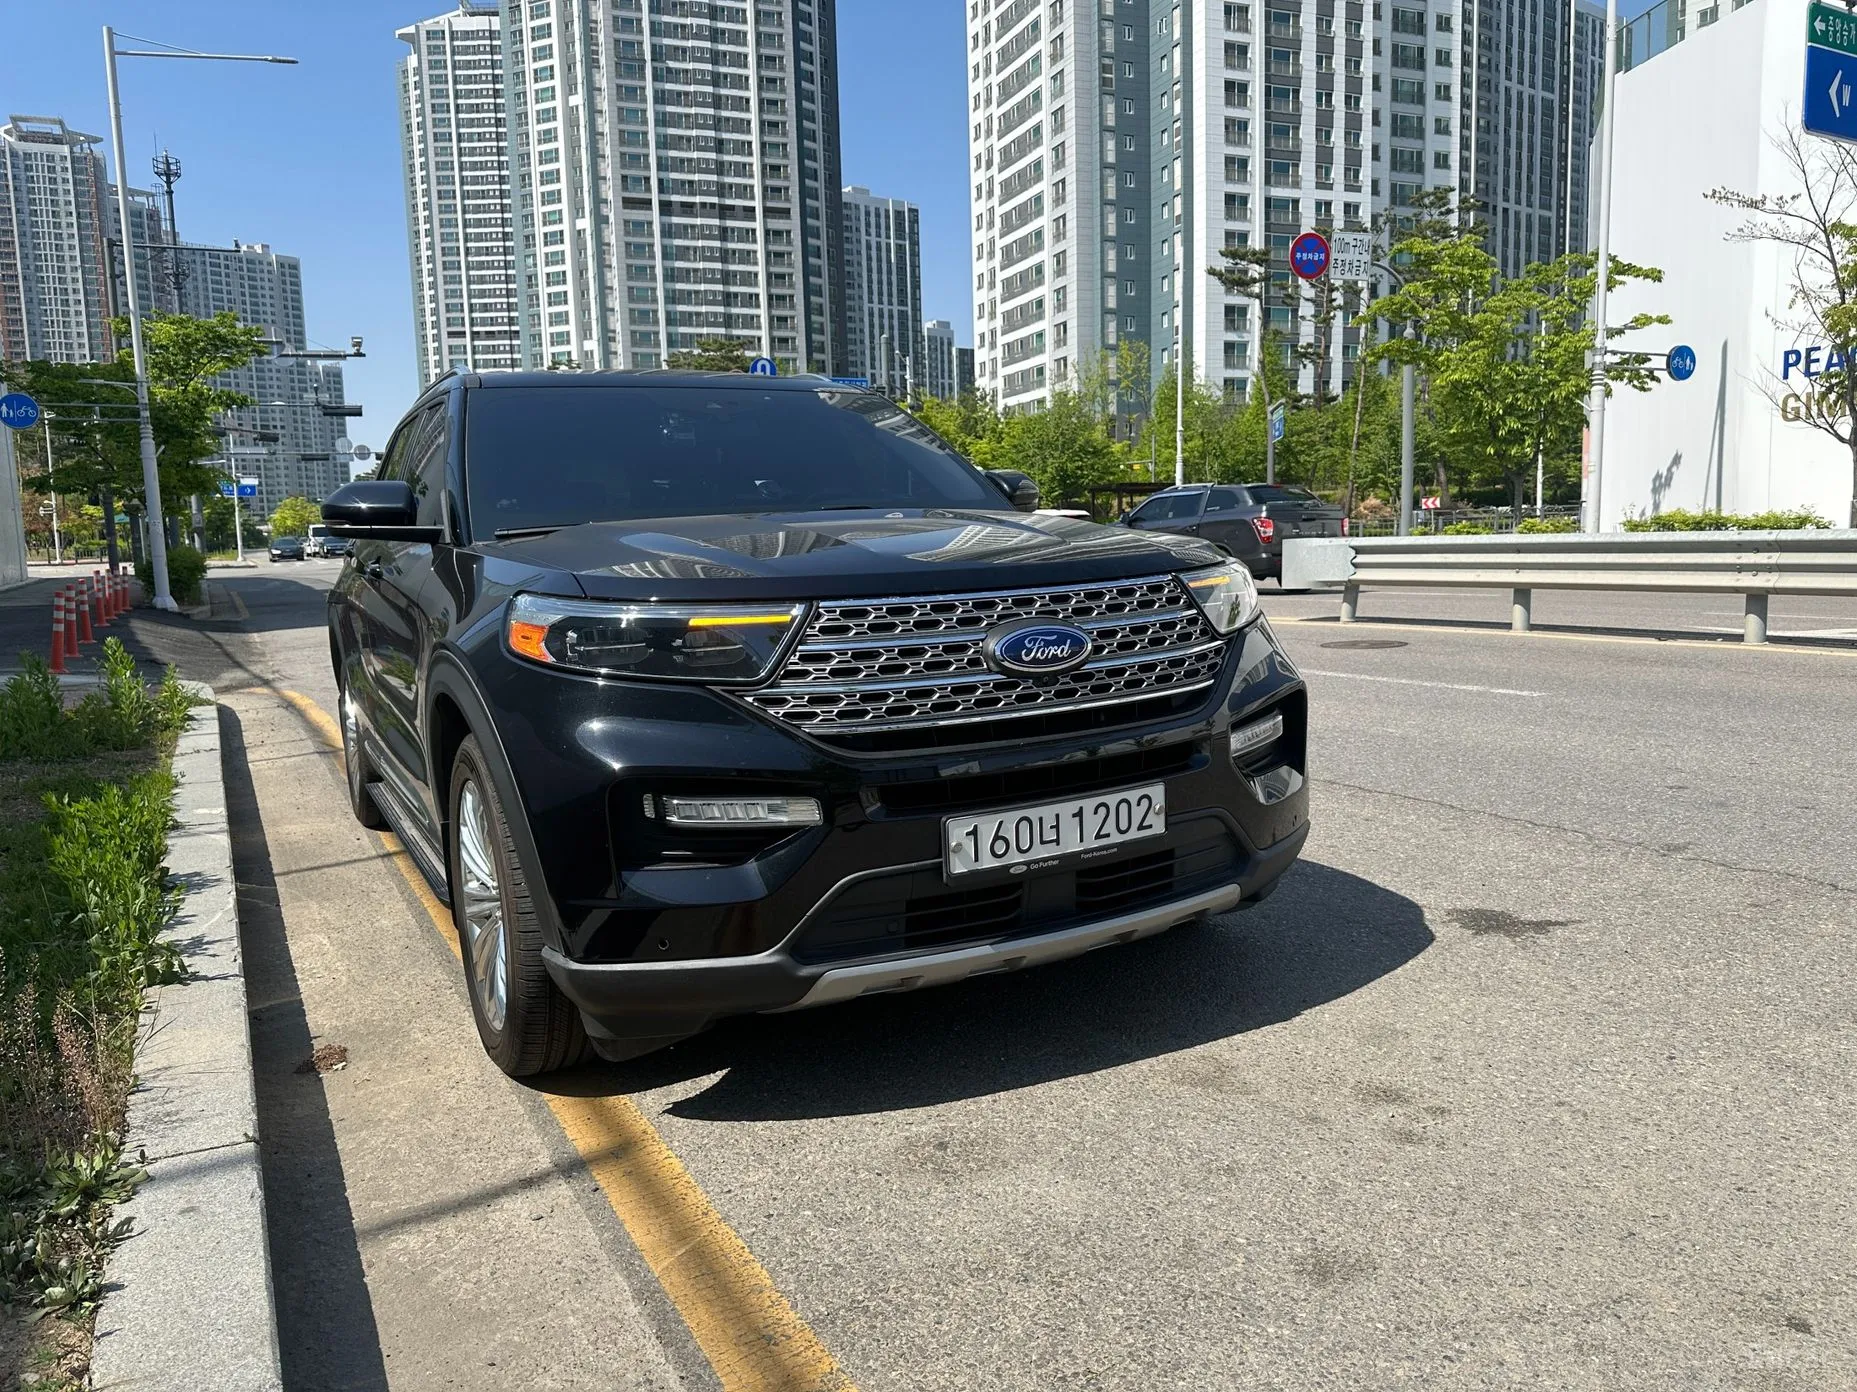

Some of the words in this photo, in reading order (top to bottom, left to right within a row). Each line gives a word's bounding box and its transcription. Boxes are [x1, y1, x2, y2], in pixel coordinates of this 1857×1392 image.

[1842, 84, 1851, 107] W
[1333, 237, 1351, 254] 100m
[1295, 252, 1325, 260] 주정차금지
[1332, 258, 1369, 276] 주정차금지
[1782, 391, 1857, 422] GIM
[1021, 635, 1071, 661] Ford
[965, 813, 1060, 863] 160너
[1071, 793, 1153, 844] 1202
[1039, 860, 1059, 868] Further
